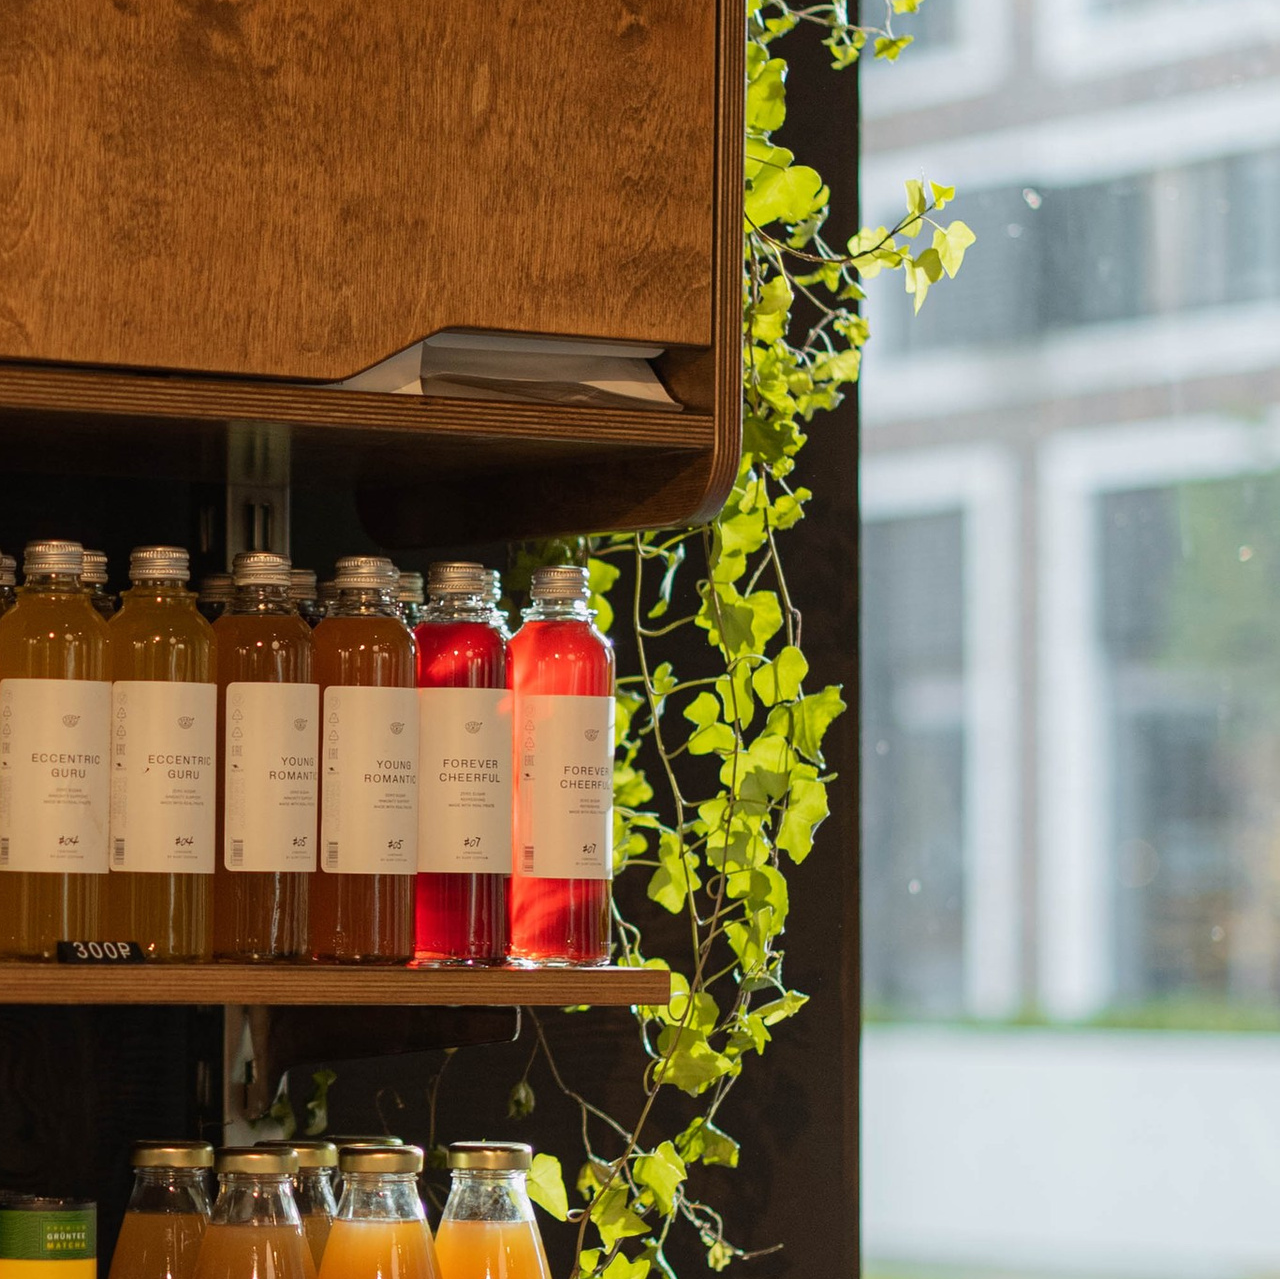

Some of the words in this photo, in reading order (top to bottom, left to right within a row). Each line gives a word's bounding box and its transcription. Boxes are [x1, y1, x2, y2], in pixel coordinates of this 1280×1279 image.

[31, 753, 101, 765] ECCENTRIC
[148, 754, 212, 766] ECCENTRIC
[281, 756, 315, 767] YOUNG
[443, 758, 499, 769] FOREVER
[376, 760, 412, 770] YOUNG
[51, 768, 86, 779] GURU
[167, 769, 200, 780] GURU
[564, 766, 609, 776] FOREVER
[364, 774, 416, 784] ROMANTIC
[439, 773, 500, 783] CHEERFUL
[463, 837, 481, 848] #07
[46, 1232, 86, 1240] GRÜNTEE
[46, 1240, 86, 1249] MATCHA
